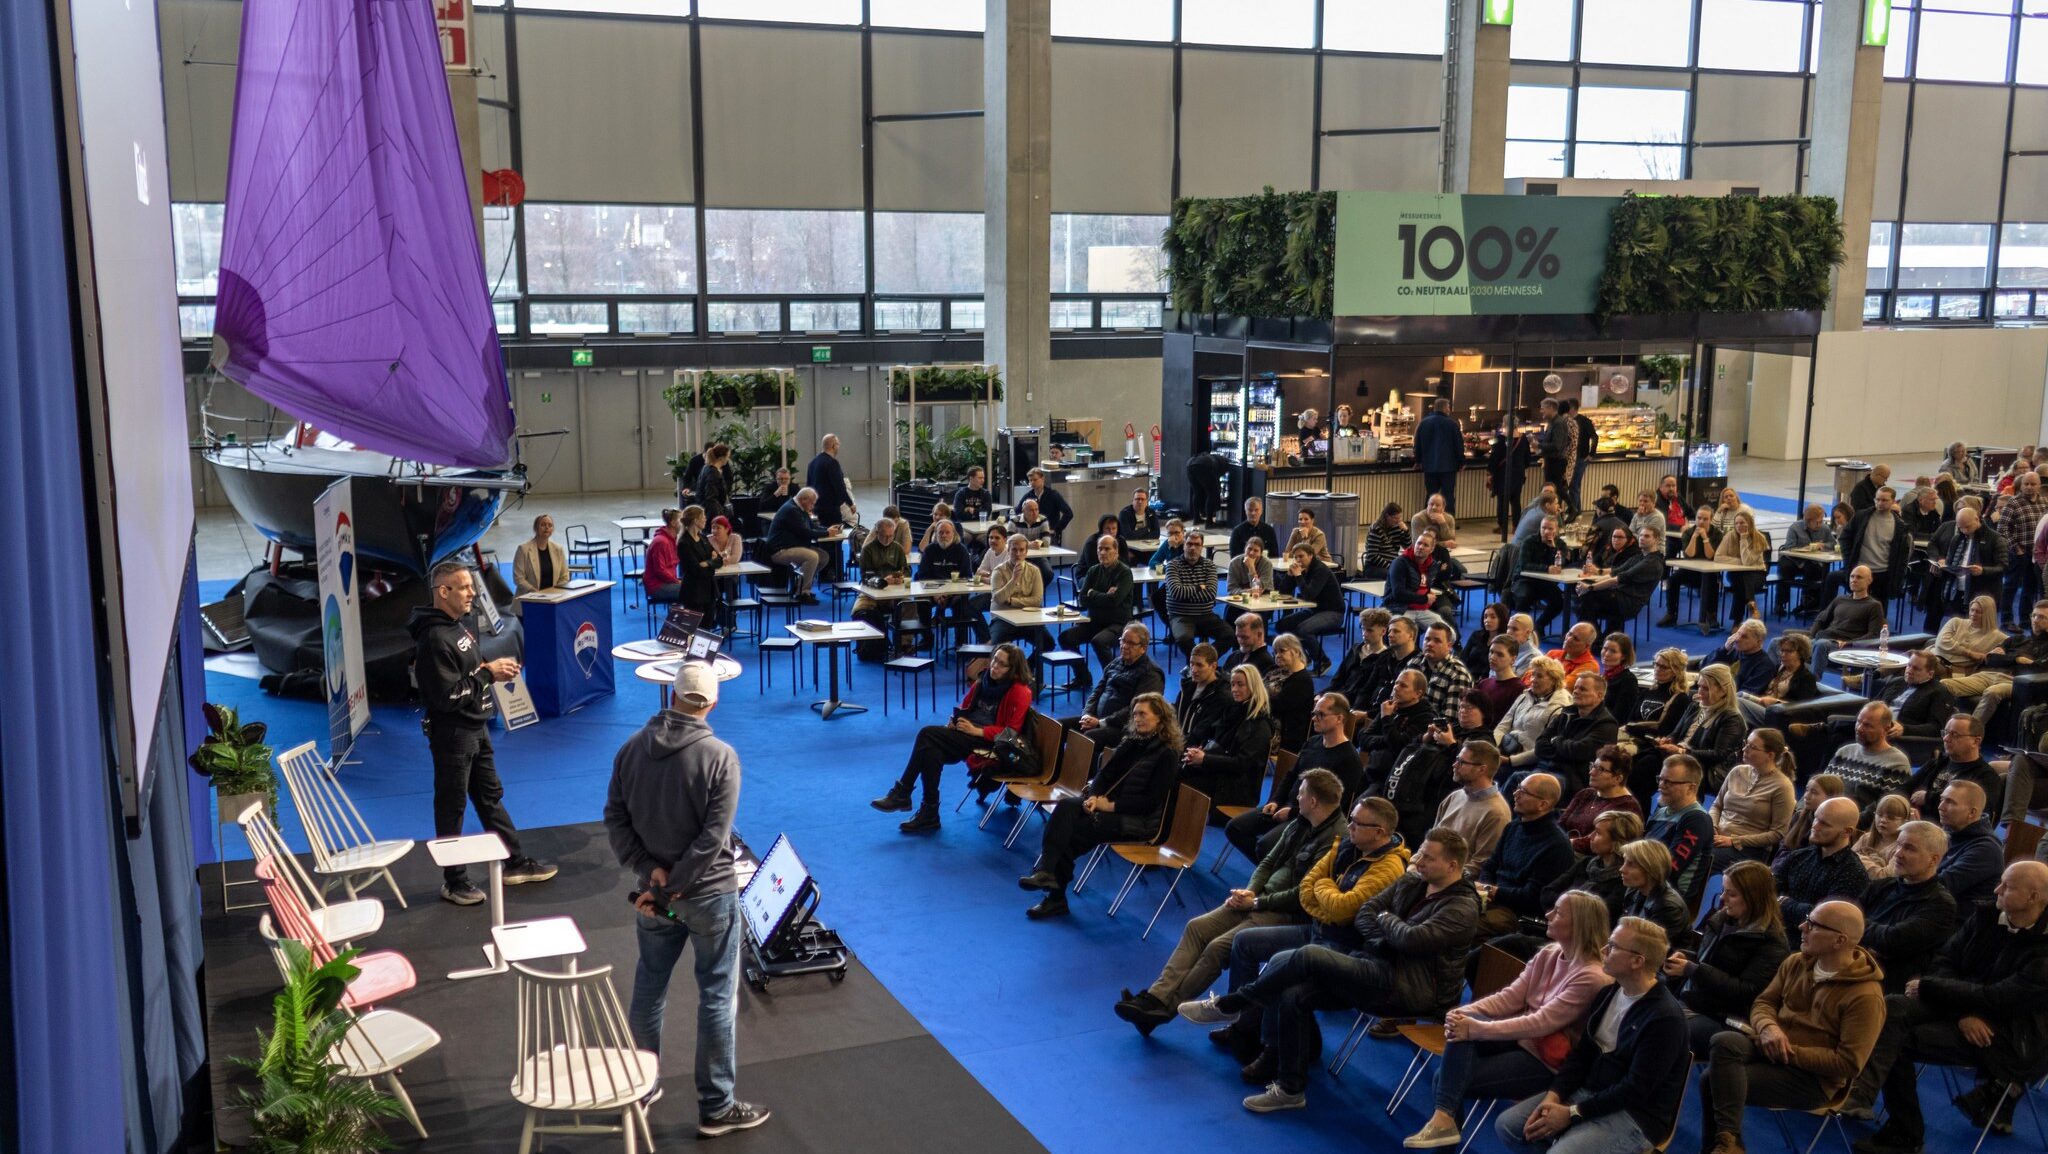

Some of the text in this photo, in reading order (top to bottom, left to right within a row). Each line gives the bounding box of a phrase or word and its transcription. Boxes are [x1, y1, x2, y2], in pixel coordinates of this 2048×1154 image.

[1397, 224, 1561, 282] 100%
[1416, 286, 1468, 296] NEUTRAALI
[1470, 286, 1493, 296] 2030
[1494, 283, 1543, 296] MENNESSÄ
